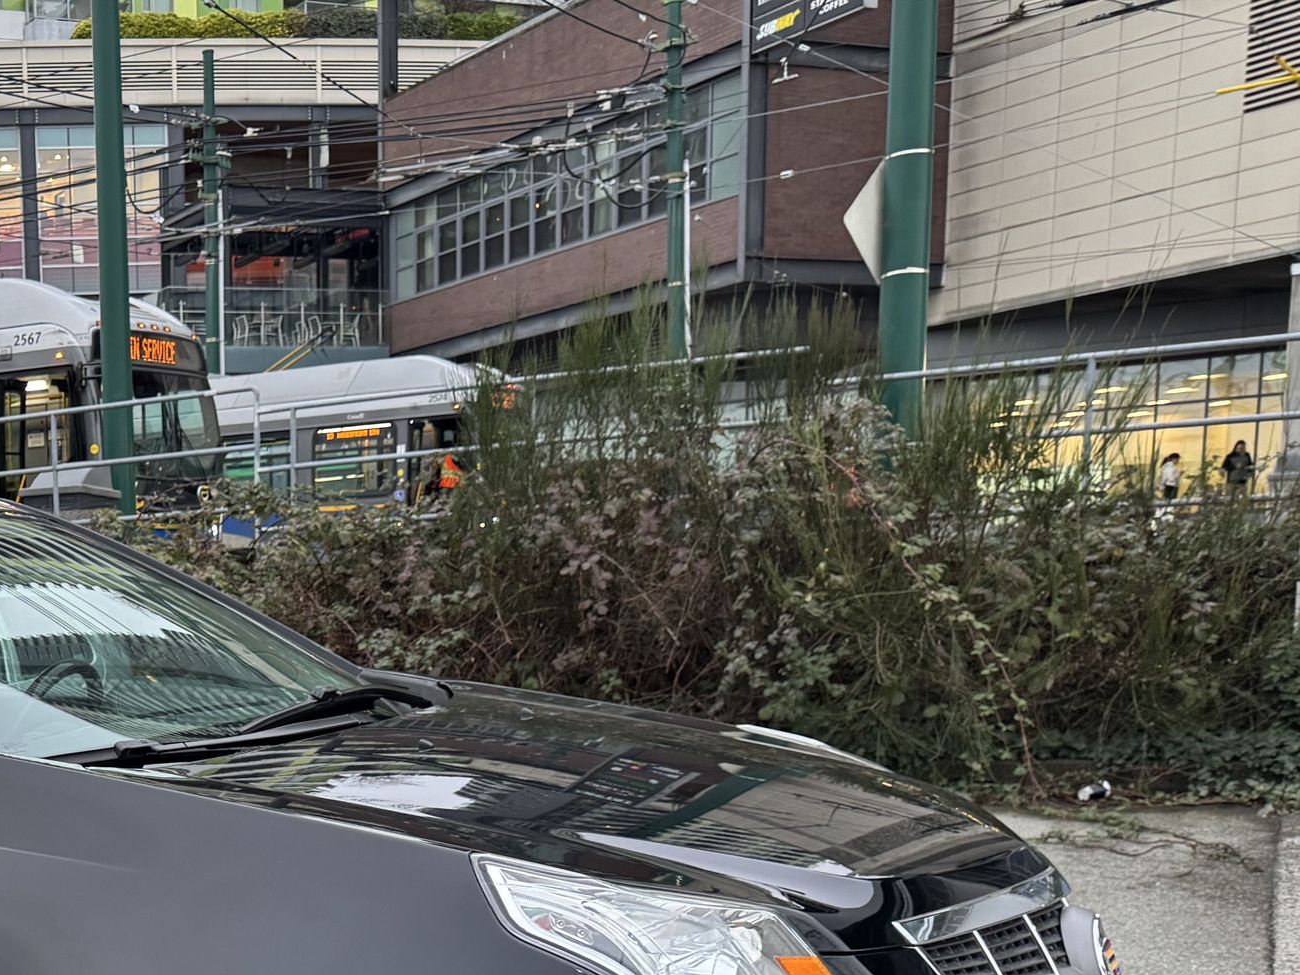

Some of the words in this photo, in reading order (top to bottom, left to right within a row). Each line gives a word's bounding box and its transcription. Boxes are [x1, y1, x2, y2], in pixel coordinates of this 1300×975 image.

[756, 9, 801, 40] SUBWAY
[13, 332, 42, 347] 2567
[142, 338, 176, 364] SERVICE
